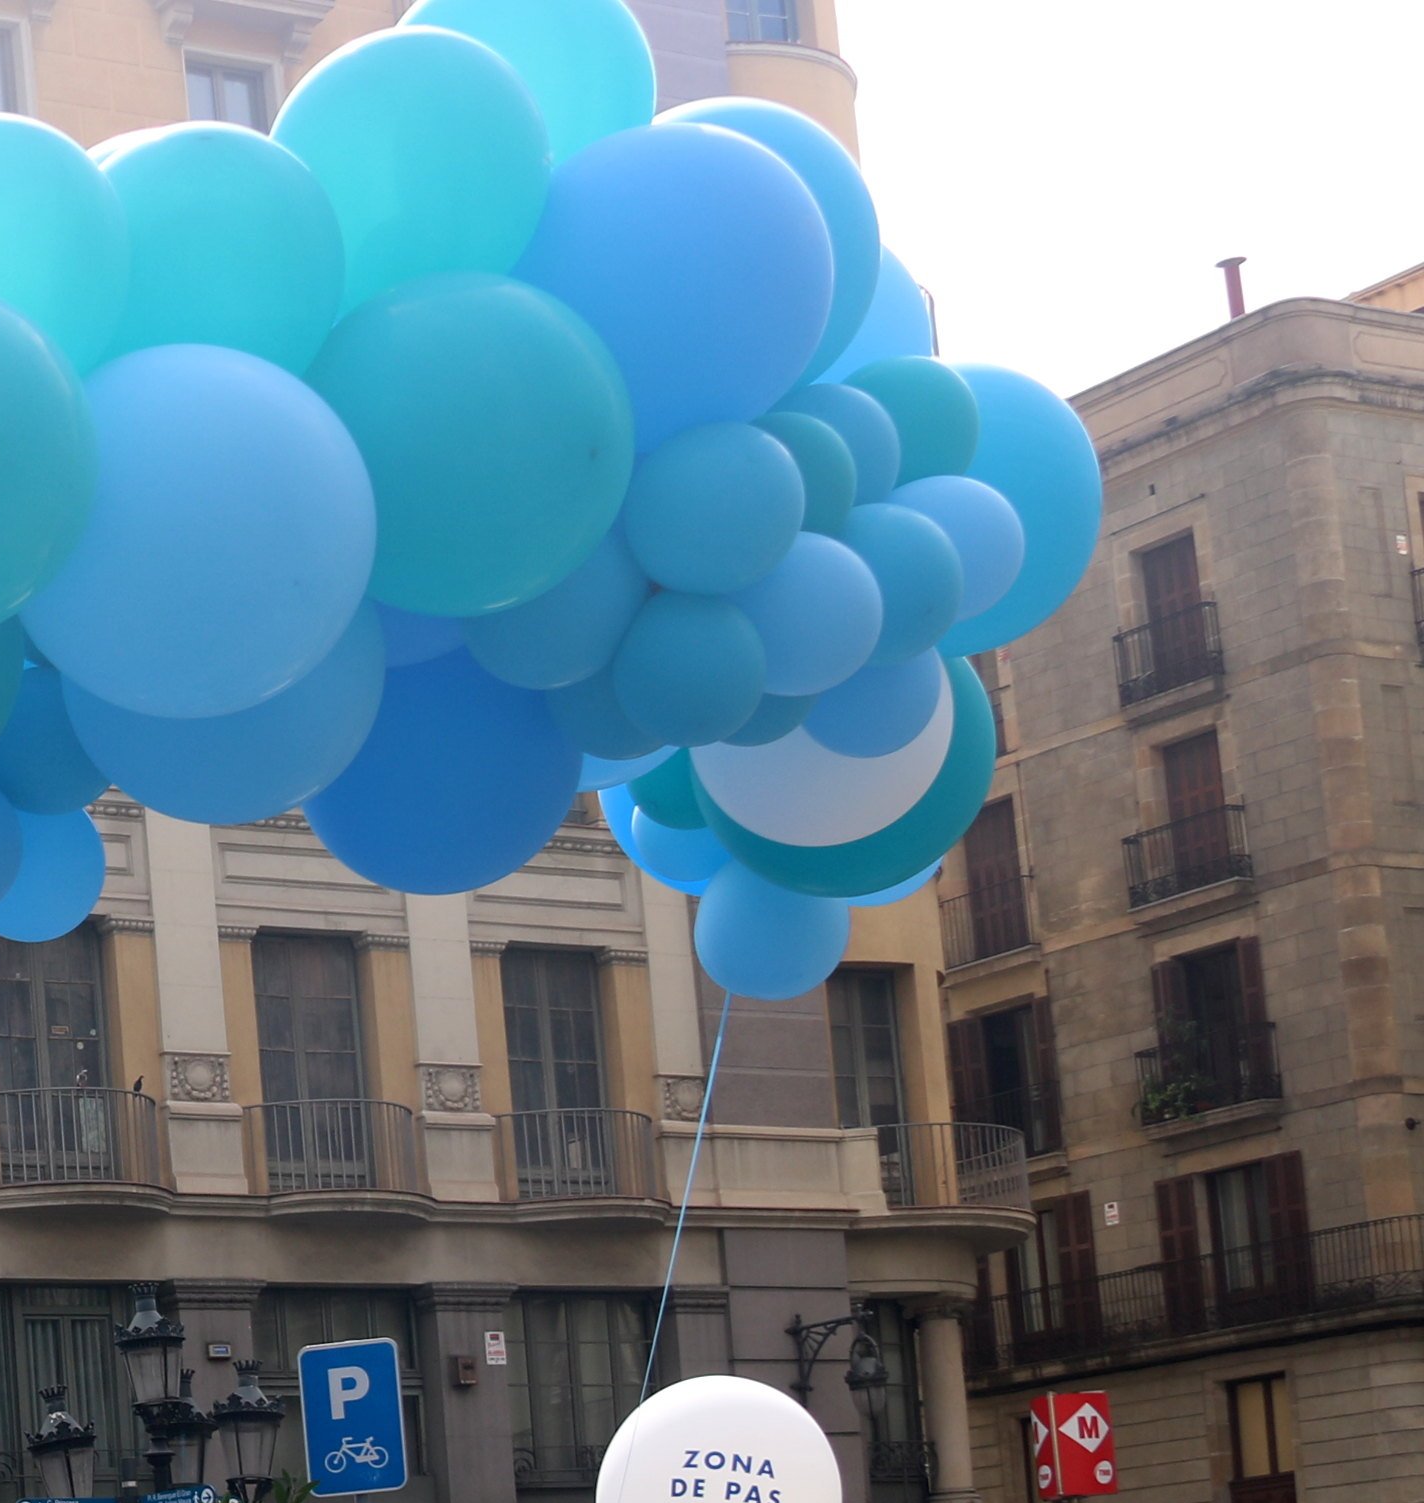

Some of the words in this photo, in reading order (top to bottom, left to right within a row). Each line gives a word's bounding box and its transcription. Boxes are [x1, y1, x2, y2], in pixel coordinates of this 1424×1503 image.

[328, 1366, 370, 1420] P
[1077, 1416, 1100, 1439] M
[683, 1450, 775, 1479] ZONA
[671, 1478, 706, 1498] DE
